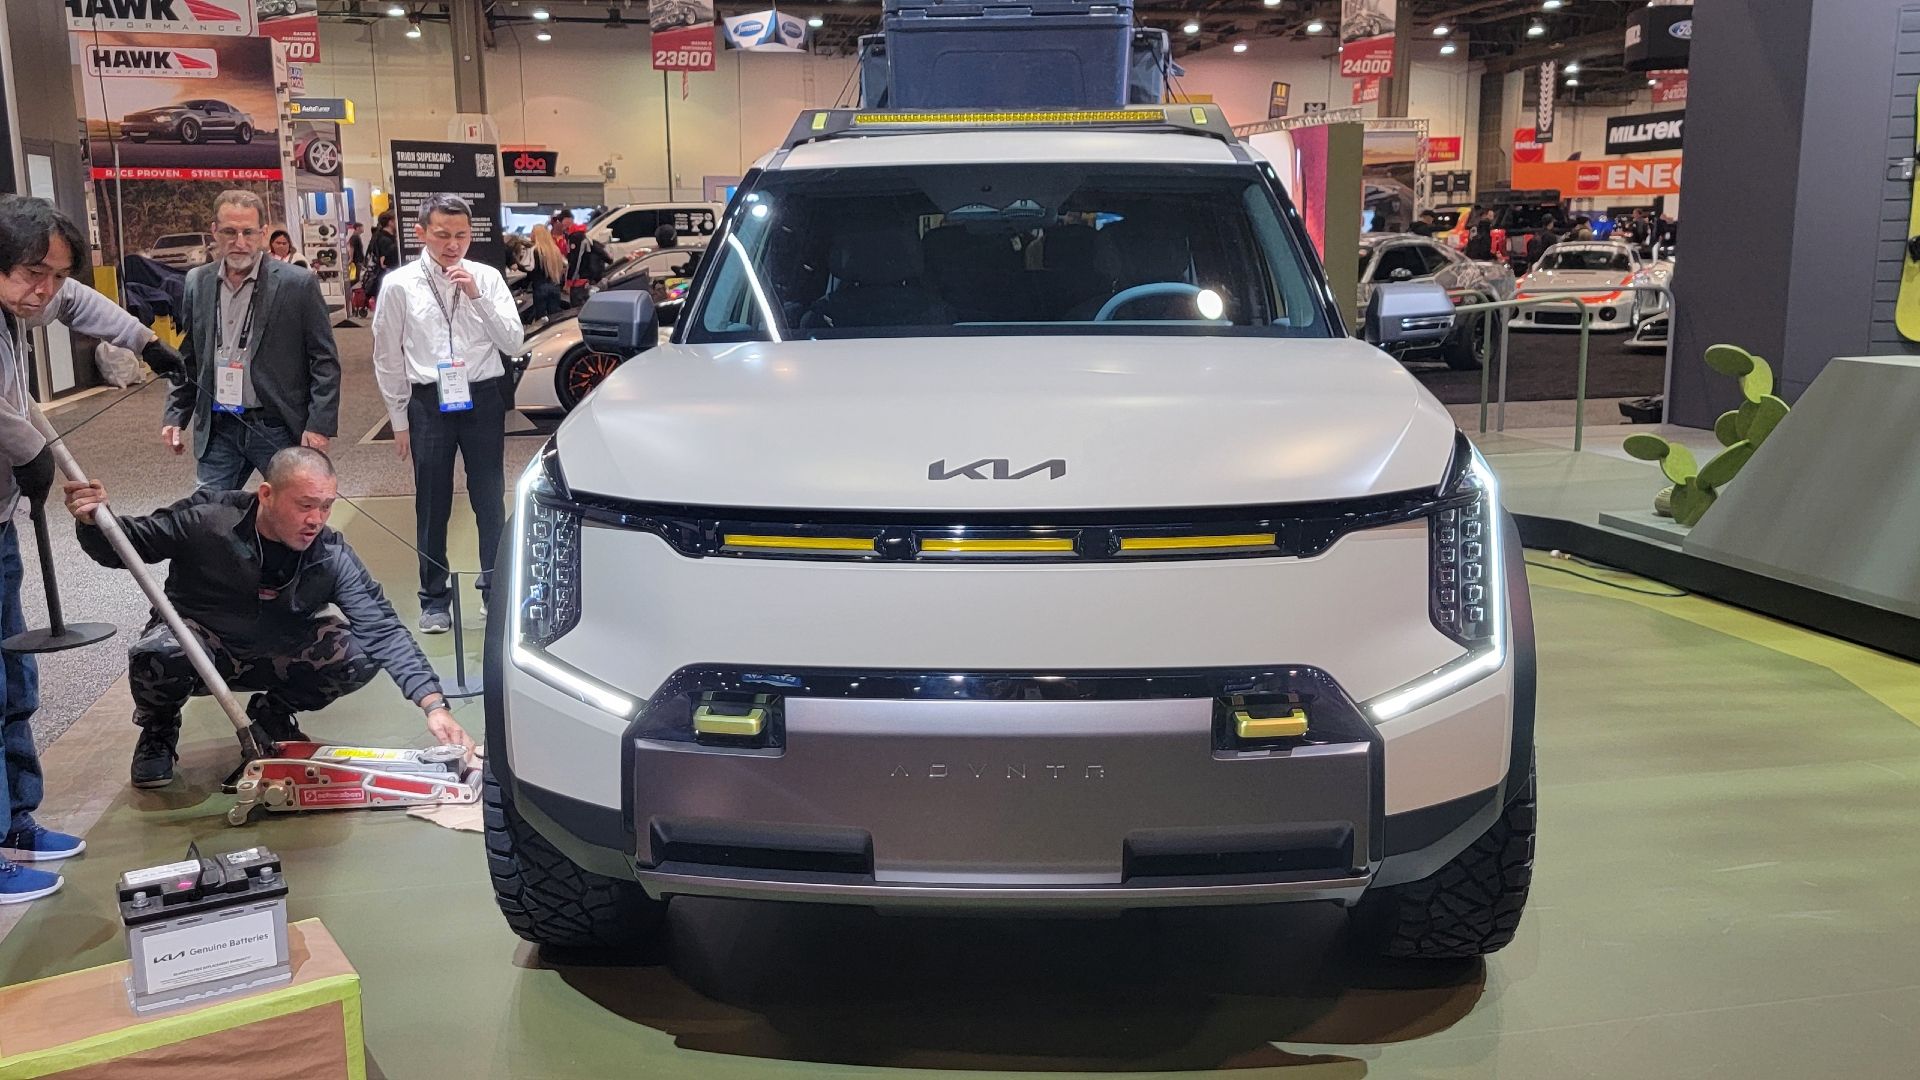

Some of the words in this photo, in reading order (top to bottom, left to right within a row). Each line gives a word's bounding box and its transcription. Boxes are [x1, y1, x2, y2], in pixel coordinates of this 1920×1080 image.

[284, 42, 315, 58] 700
[92, 49, 173, 69] HAWK
[655, 51, 712, 66] 23800
[1343, 59, 1391, 74] 24000
[514, 153, 547, 169] dba
[137, 169, 183, 178] PROVEN.
[191, 170, 230, 178] STREET
[233, 170, 269, 178] LEGAL.
[928, 459, 1066, 480] KIA
[890, 763, 1105, 778] ADVNTR
[154, 951, 185, 964] KIA
[189, 940, 228, 956] Genuine
[229, 932, 269, 948] Batteries
